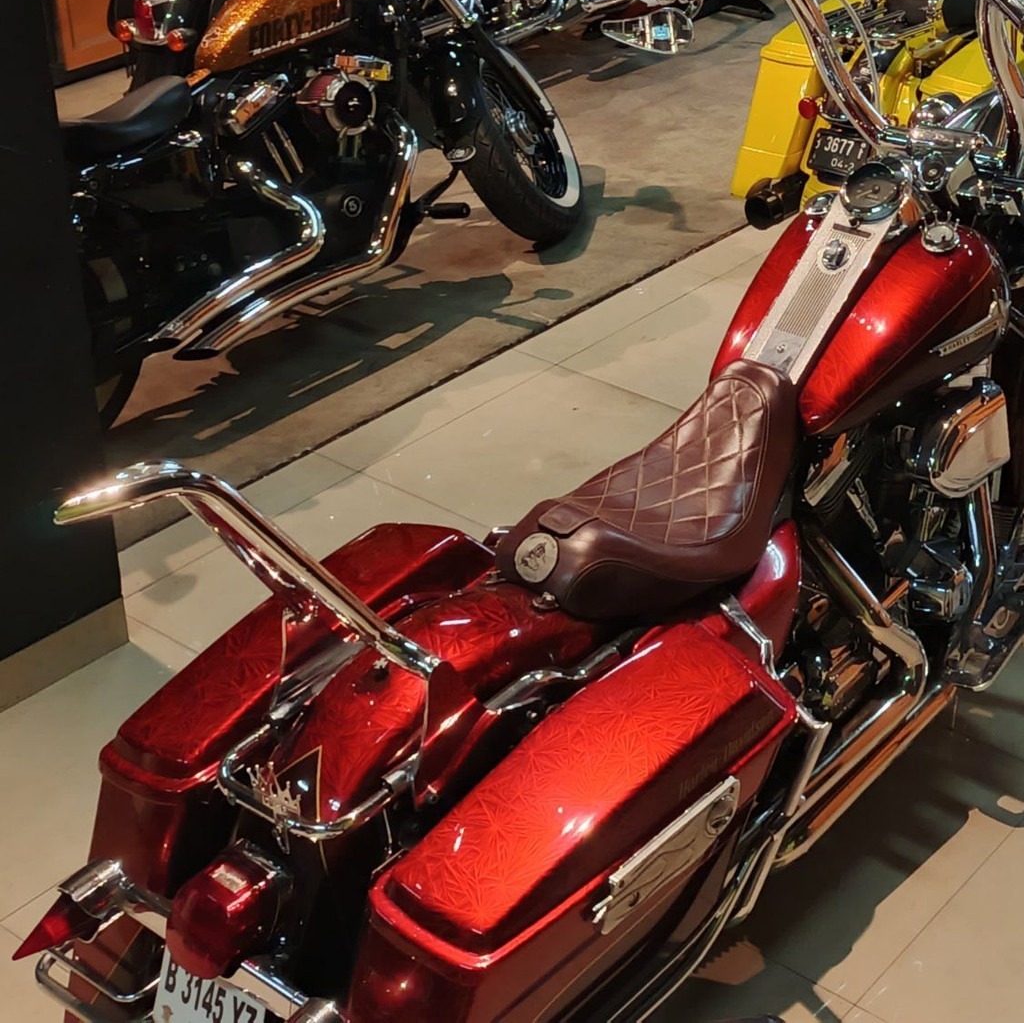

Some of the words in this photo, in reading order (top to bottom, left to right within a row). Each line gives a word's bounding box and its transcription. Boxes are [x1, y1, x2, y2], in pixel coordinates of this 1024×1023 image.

[824, 136, 855, 156] 3677
[165, 958, 179, 993] B
[181, 971, 226, 1023] 3145
